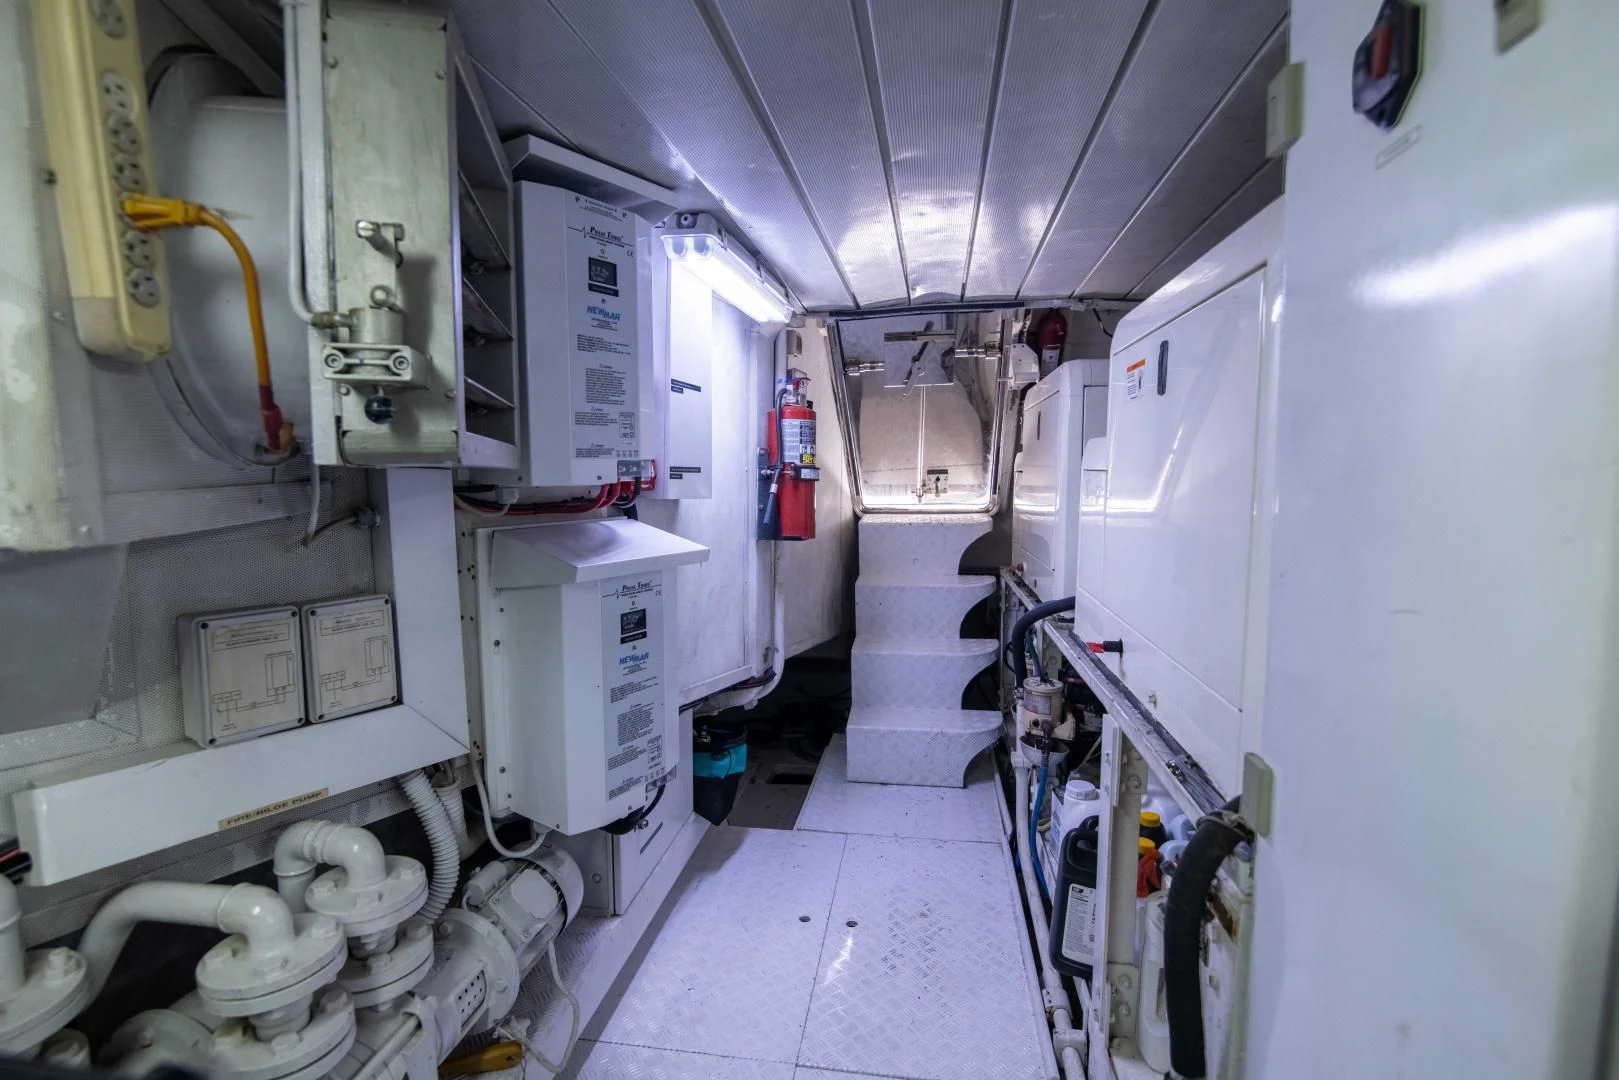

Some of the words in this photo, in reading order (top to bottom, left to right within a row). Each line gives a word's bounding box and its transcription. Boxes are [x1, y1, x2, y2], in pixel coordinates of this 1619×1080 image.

[587, 305, 620, 321] NEWMAR
[619, 652, 649, 665] NEWMAR
[291, 791, 322, 805] PUMP
